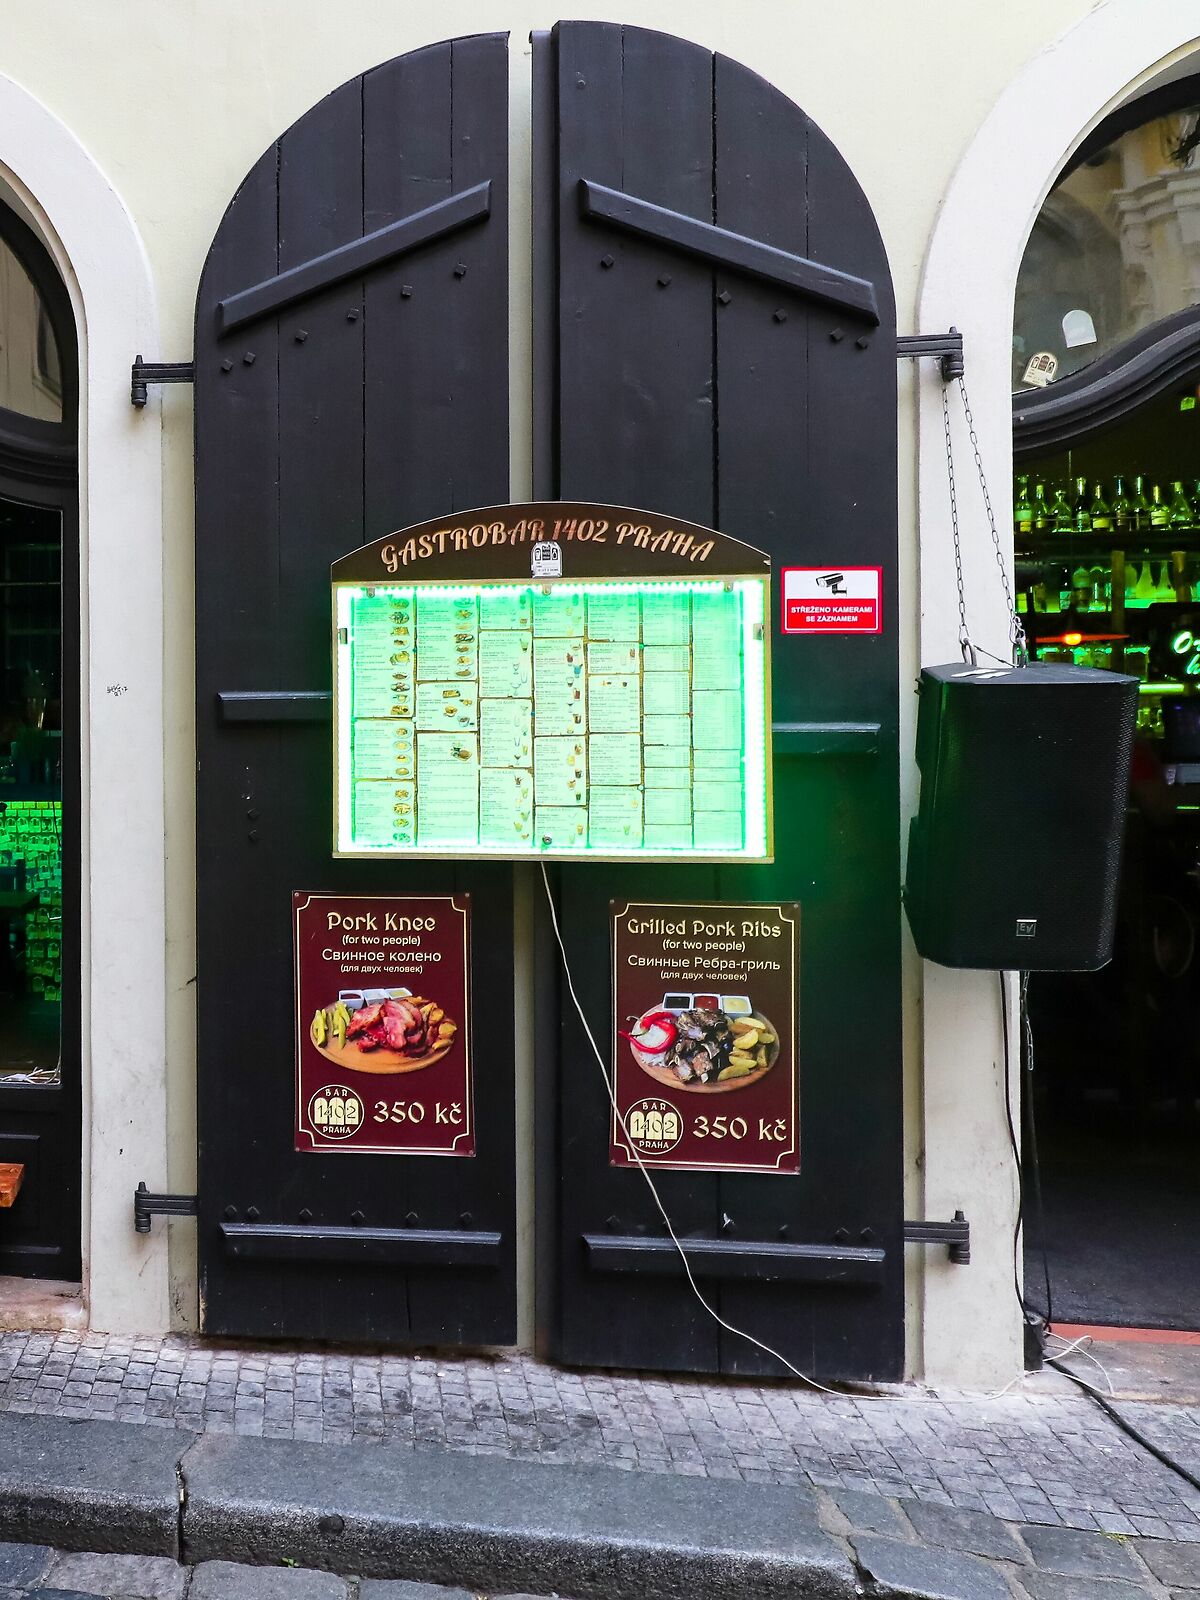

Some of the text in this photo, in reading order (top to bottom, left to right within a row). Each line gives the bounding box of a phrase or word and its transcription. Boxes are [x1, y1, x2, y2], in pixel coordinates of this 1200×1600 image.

[381, 518, 545, 573] GASTROBAR
[552, 519, 609, 543] 1402
[616, 522, 715, 562] PRAHA
[791, 605, 831, 613] STŘEŽENO
[816, 614, 858, 622] ZÁZNAMEM
[327, 911, 436, 932] Pork Knee
[627, 918, 782, 938] Grilled Pork Ribs
[342, 934, 421, 947] (for two people)
[662, 939, 746, 953] (for two people)
[322, 948, 442, 962] Свинное колено
[340, 963, 423, 974] (для двух человек)
[627, 954, 781, 972] Свинные Ребра-гриль
[660, 970, 748, 982] (для двух человек)
[325, 1088, 348, 1097] BAR
[373, 1101, 462, 1125] 350 kč
[642, 1102, 666, 1111] BAR
[323, 1125, 351, 1134] PRAHA
[693, 1115, 787, 1142] 350 kč
[639, 1140, 669, 1149] PRAHA
